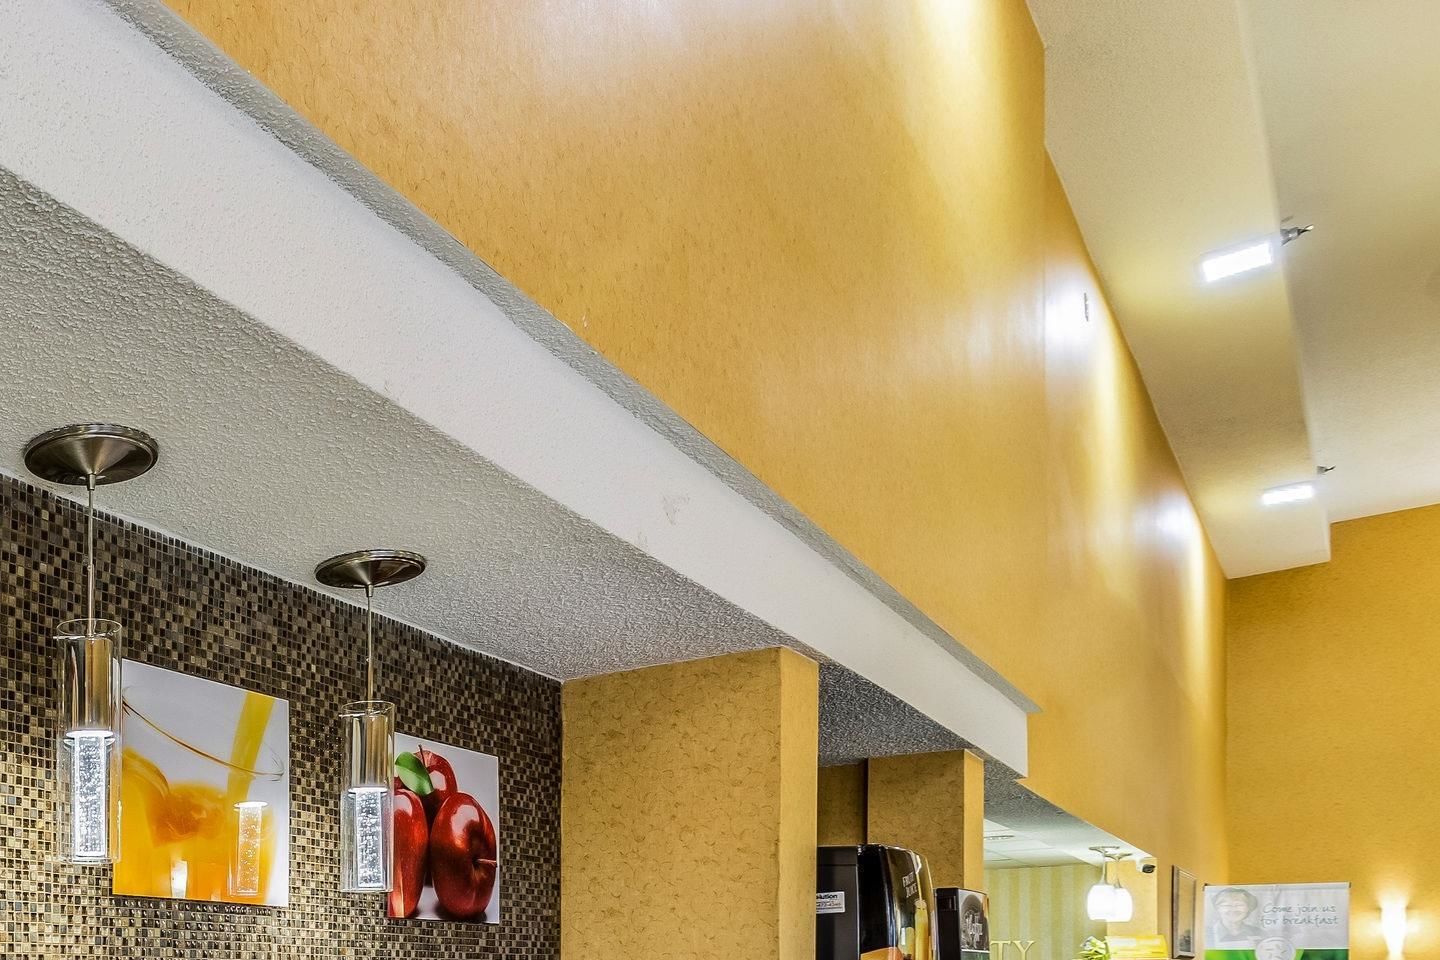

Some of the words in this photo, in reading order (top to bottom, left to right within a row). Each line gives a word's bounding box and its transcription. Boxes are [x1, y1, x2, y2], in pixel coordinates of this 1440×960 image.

[1262, 904, 1293, 914] Come
[1297, 904, 1319, 917] join
[1320, 905, 1337, 914] us
[1260, 917, 1279, 928] for
[1282, 915, 1339, 928] breakfast
